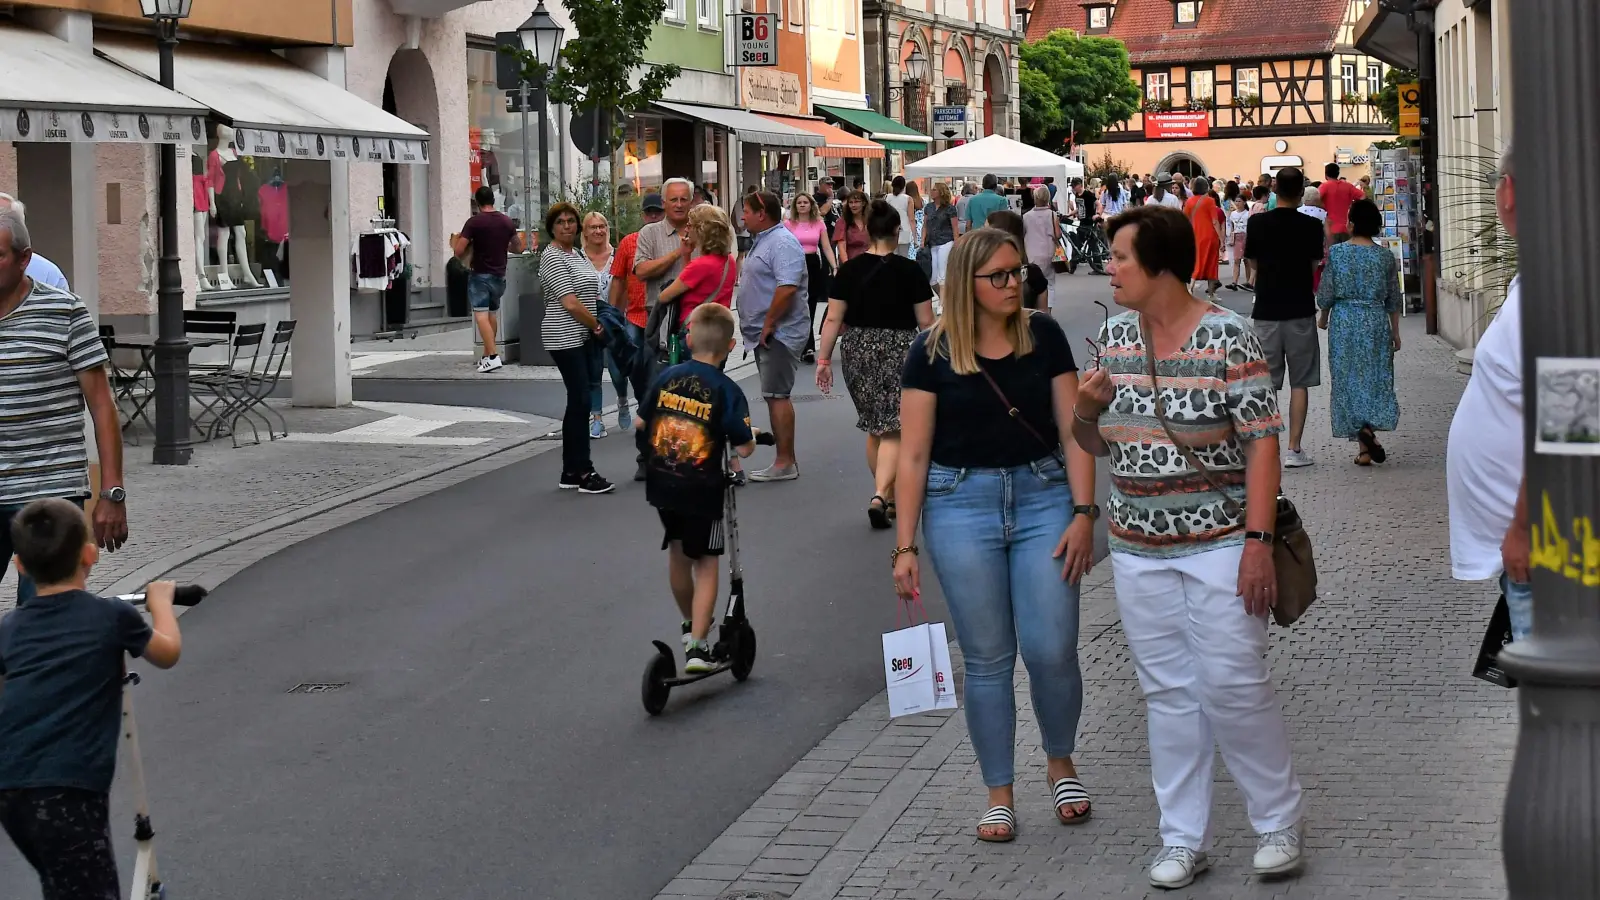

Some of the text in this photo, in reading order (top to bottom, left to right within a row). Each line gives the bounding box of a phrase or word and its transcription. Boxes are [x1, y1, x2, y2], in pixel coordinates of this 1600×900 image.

[742, 16, 768, 40] B6
[742, 51, 768, 63] Seeg
[657, 389, 713, 421] FORTNITE
[891, 656, 913, 672] Seeg
